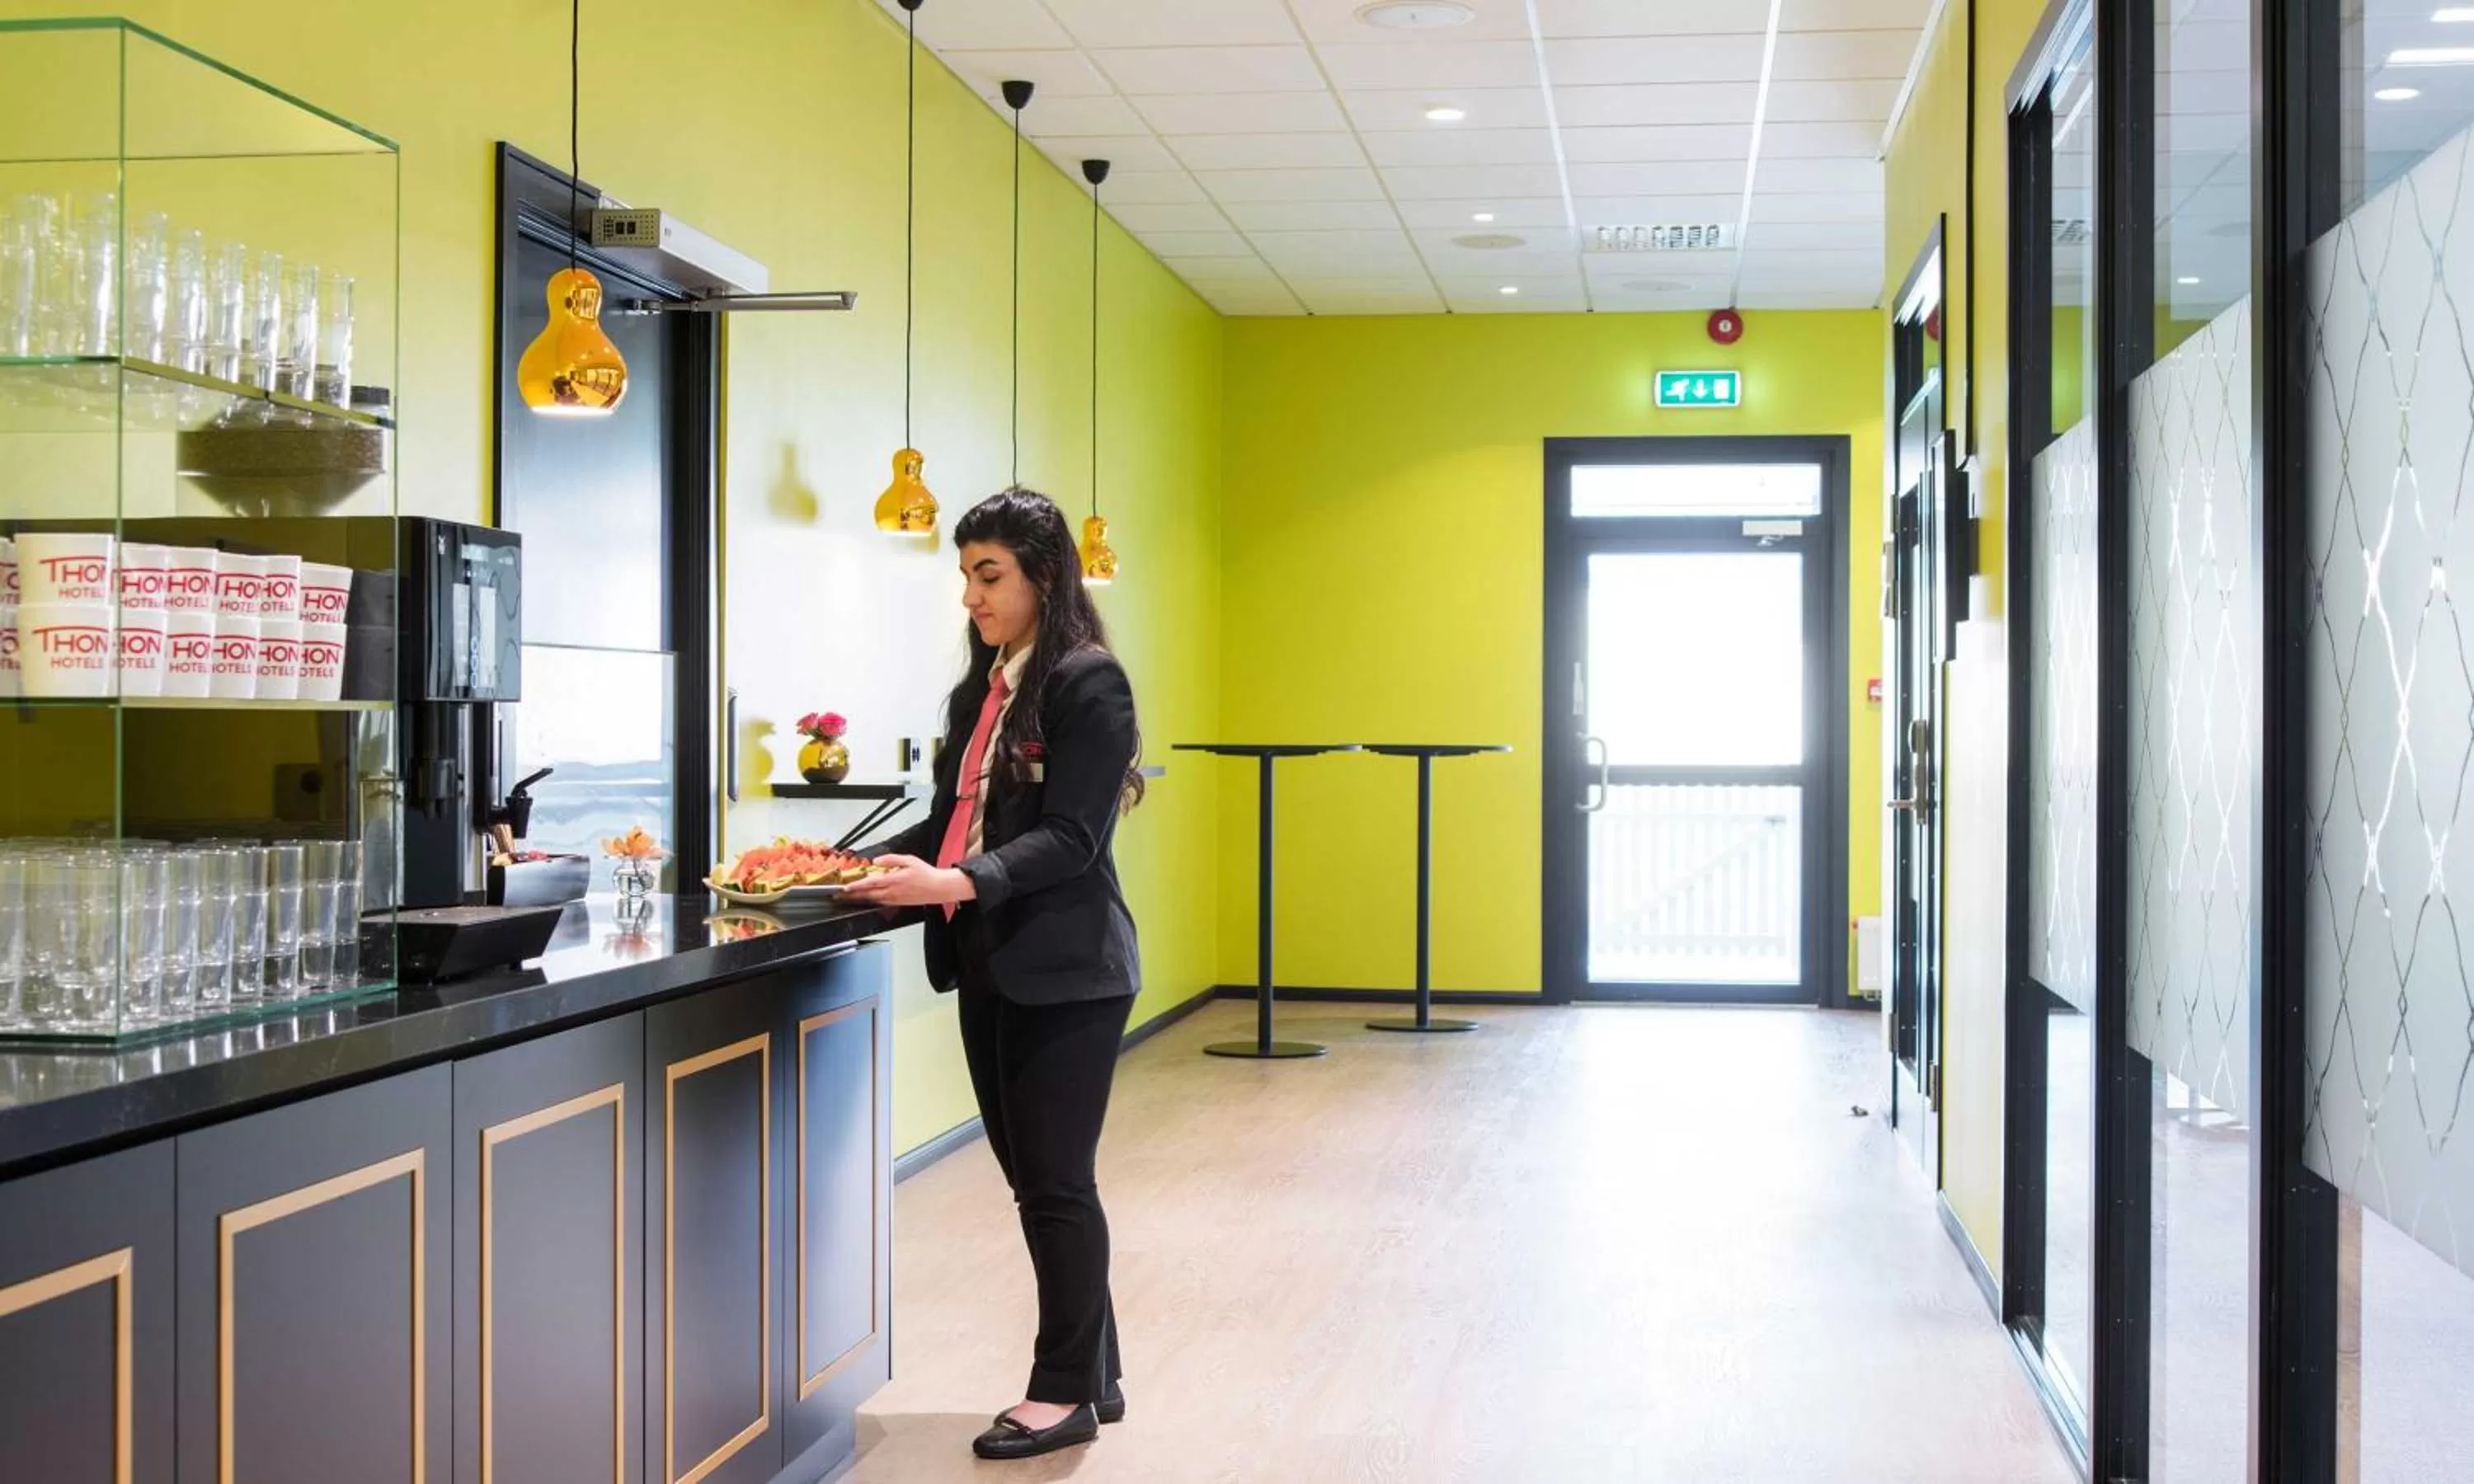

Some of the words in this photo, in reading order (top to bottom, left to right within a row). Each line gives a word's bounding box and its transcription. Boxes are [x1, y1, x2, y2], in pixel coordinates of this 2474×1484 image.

[166, 567, 211, 593] HON
[59, 588, 106, 598] HOTEL
[300, 586, 349, 611] HON
[32, 626, 108, 653] THON
[166, 633, 211, 659] HO
[213, 635, 256, 660] HON
[258, 638, 299, 662] HON
